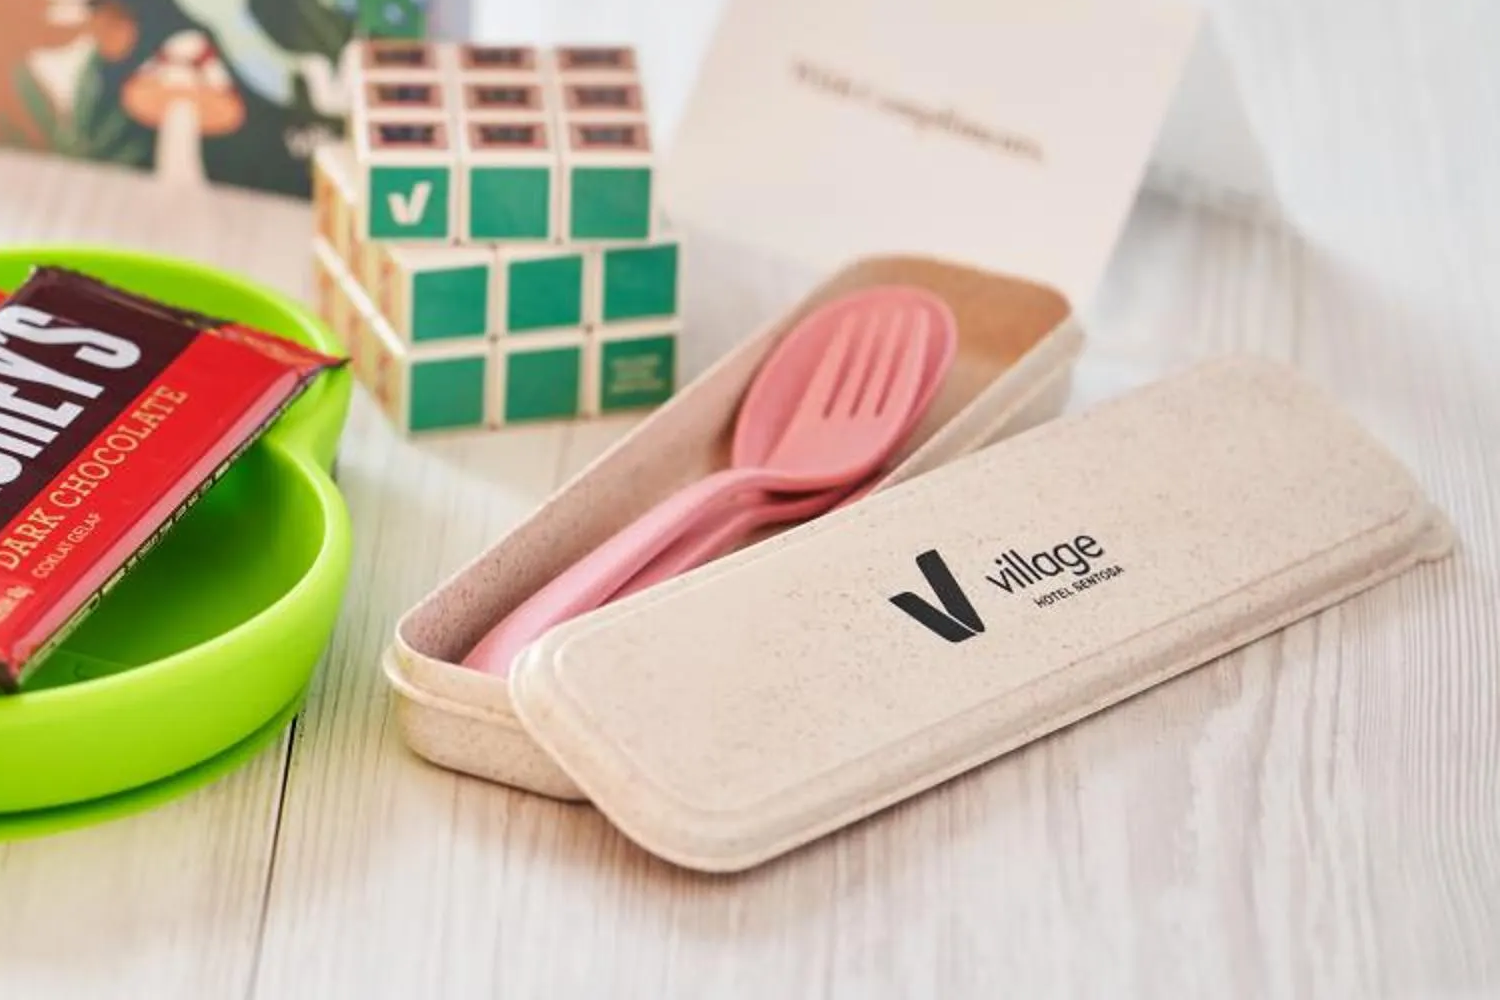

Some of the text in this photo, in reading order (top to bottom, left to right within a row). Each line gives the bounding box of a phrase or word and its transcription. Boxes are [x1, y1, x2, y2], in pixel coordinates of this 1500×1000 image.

[49, 385, 189, 509] CHOCOLATE
[985, 534, 1105, 594] village
[1033, 565, 1125, 609] HOTEL SENTOSA
